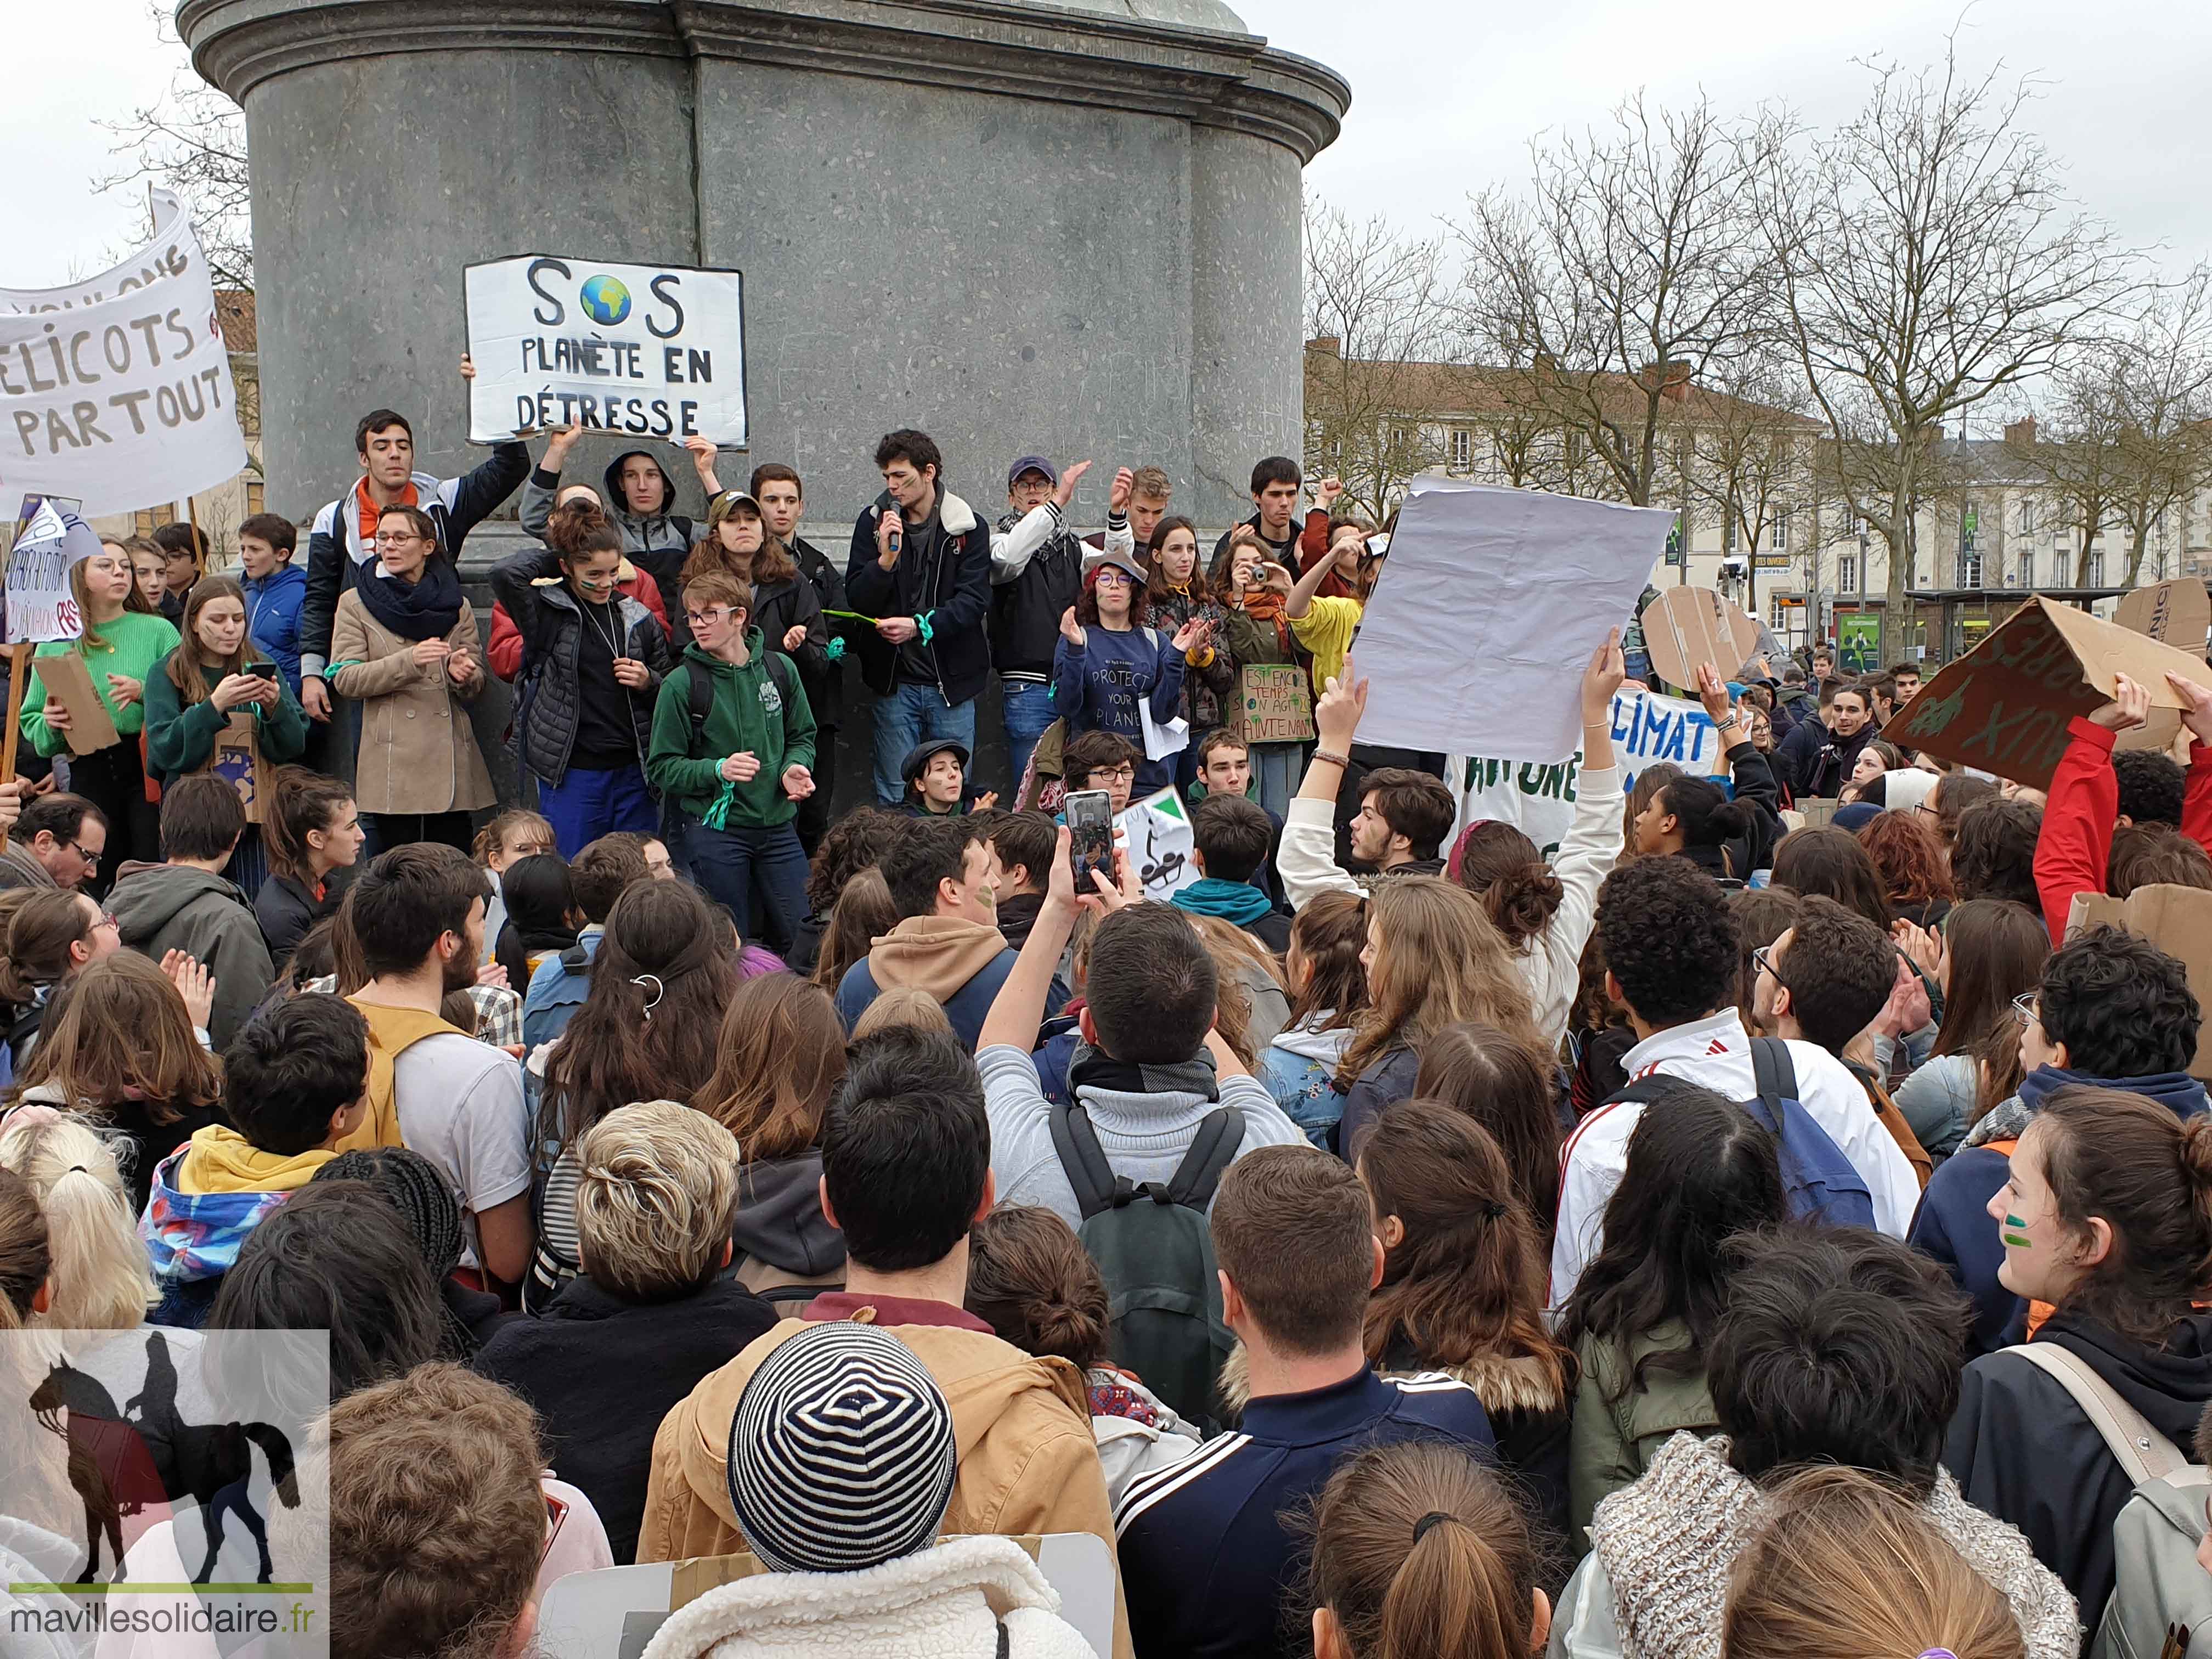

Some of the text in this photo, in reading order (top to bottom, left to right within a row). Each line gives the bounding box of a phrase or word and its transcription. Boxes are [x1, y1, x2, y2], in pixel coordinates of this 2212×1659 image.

[522, 332, 712, 382] PLANÈTE EN
[518, 385, 698, 435] DÉTRESSE
[2149, 590, 2168, 640] NIC
[1092, 669, 1150, 689] PROTECT
[1246, 669, 1266, 687] EST
[1108, 693, 1132, 706] YOUR
[1251, 687, 1289, 698] TEMPS
[1096, 708, 1141, 727] PLANE
[1611, 693, 1716, 761] LIMAT
